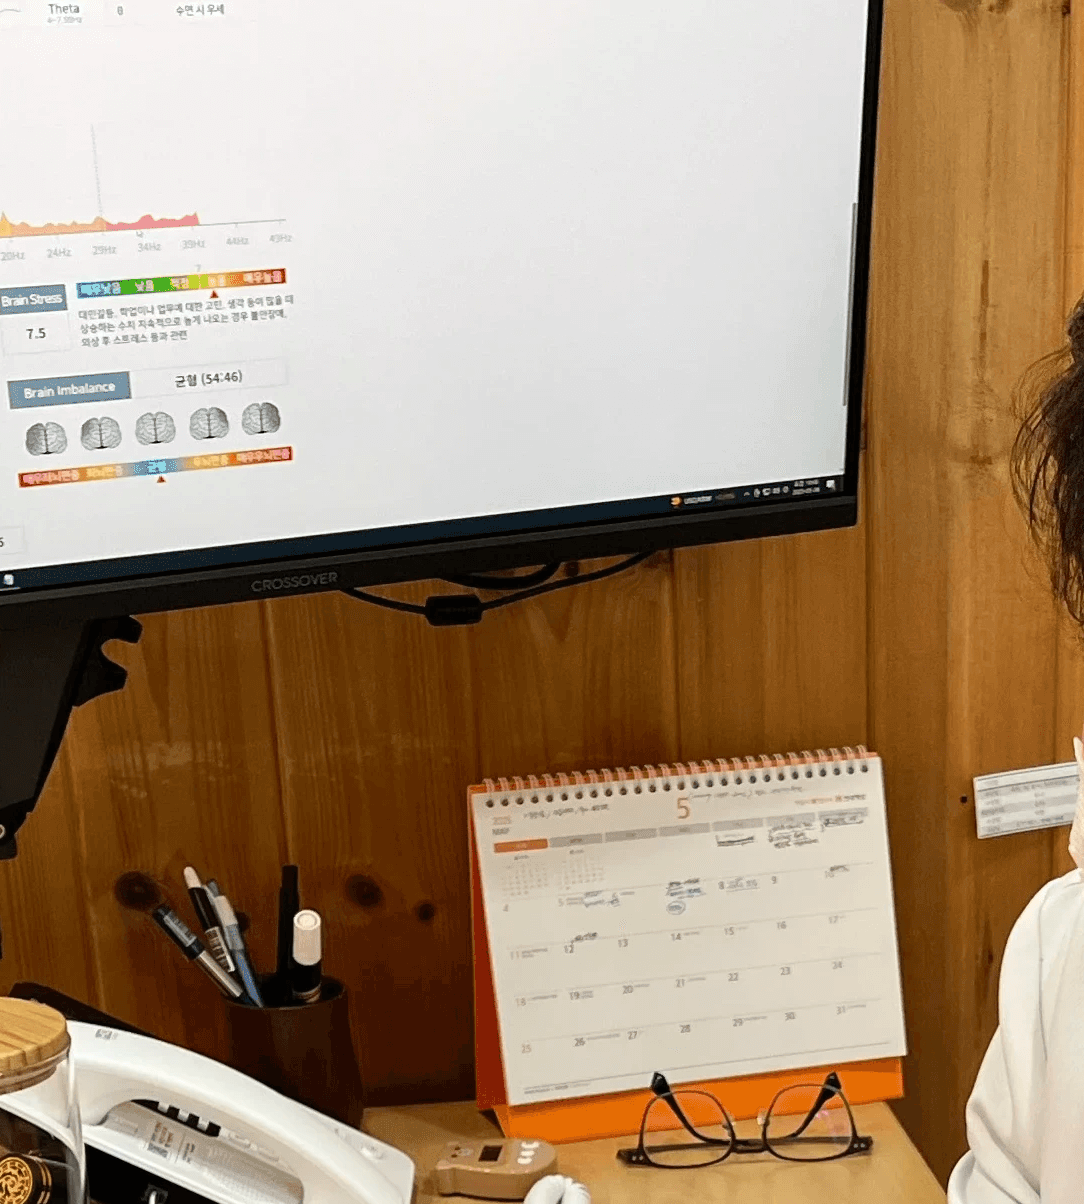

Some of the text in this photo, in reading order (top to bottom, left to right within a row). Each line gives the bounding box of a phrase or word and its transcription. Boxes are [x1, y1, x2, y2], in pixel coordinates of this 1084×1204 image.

[48, 3, 80, 14] Theta
[206, 3, 225, 15] 우세
[137, 241, 162, 252] 34Hz
[0, 292, 63, 307] Brain Stress
[226, 298, 246, 310] 생각
[118, 319, 137, 332] 수치
[203, 312, 230, 325] 나오는
[231, 310, 249, 323] 경우
[26, 327, 47, 340] 7.5
[81, 335, 100, 348] 외상
[113, 331, 148, 345] 스트레스
[169, 329, 188, 341] 관련
[175, 369, 243, 389] 균형 (54:46)
[23, 381, 116, 400] Brain Imbalance
[251, 571, 339, 592] CROSSOVER
[677, 797, 690, 819] 5
[772, 875, 777, 884] 9
[828, 915, 839, 925] 17
[776, 921, 787, 930] 16
[724, 926, 735, 936] 15
[671, 932, 682, 942] 14
[618, 938, 629, 948] 13
[832, 960, 843, 970] 24
[780, 966, 791, 976] 23
[728, 972, 739, 982] 22
[675, 978, 685, 988] 21
[622, 985, 634, 994] 20
[569, 991, 580, 1000] 19
[836, 1005, 846, 1015] 31
[784, 1011, 796, 1021] 30
[732, 1018, 744, 1028] 29
[679, 1024, 691, 1034] 28
[627, 1030, 638, 1040] 27
[574, 1037, 586, 1047] 26
